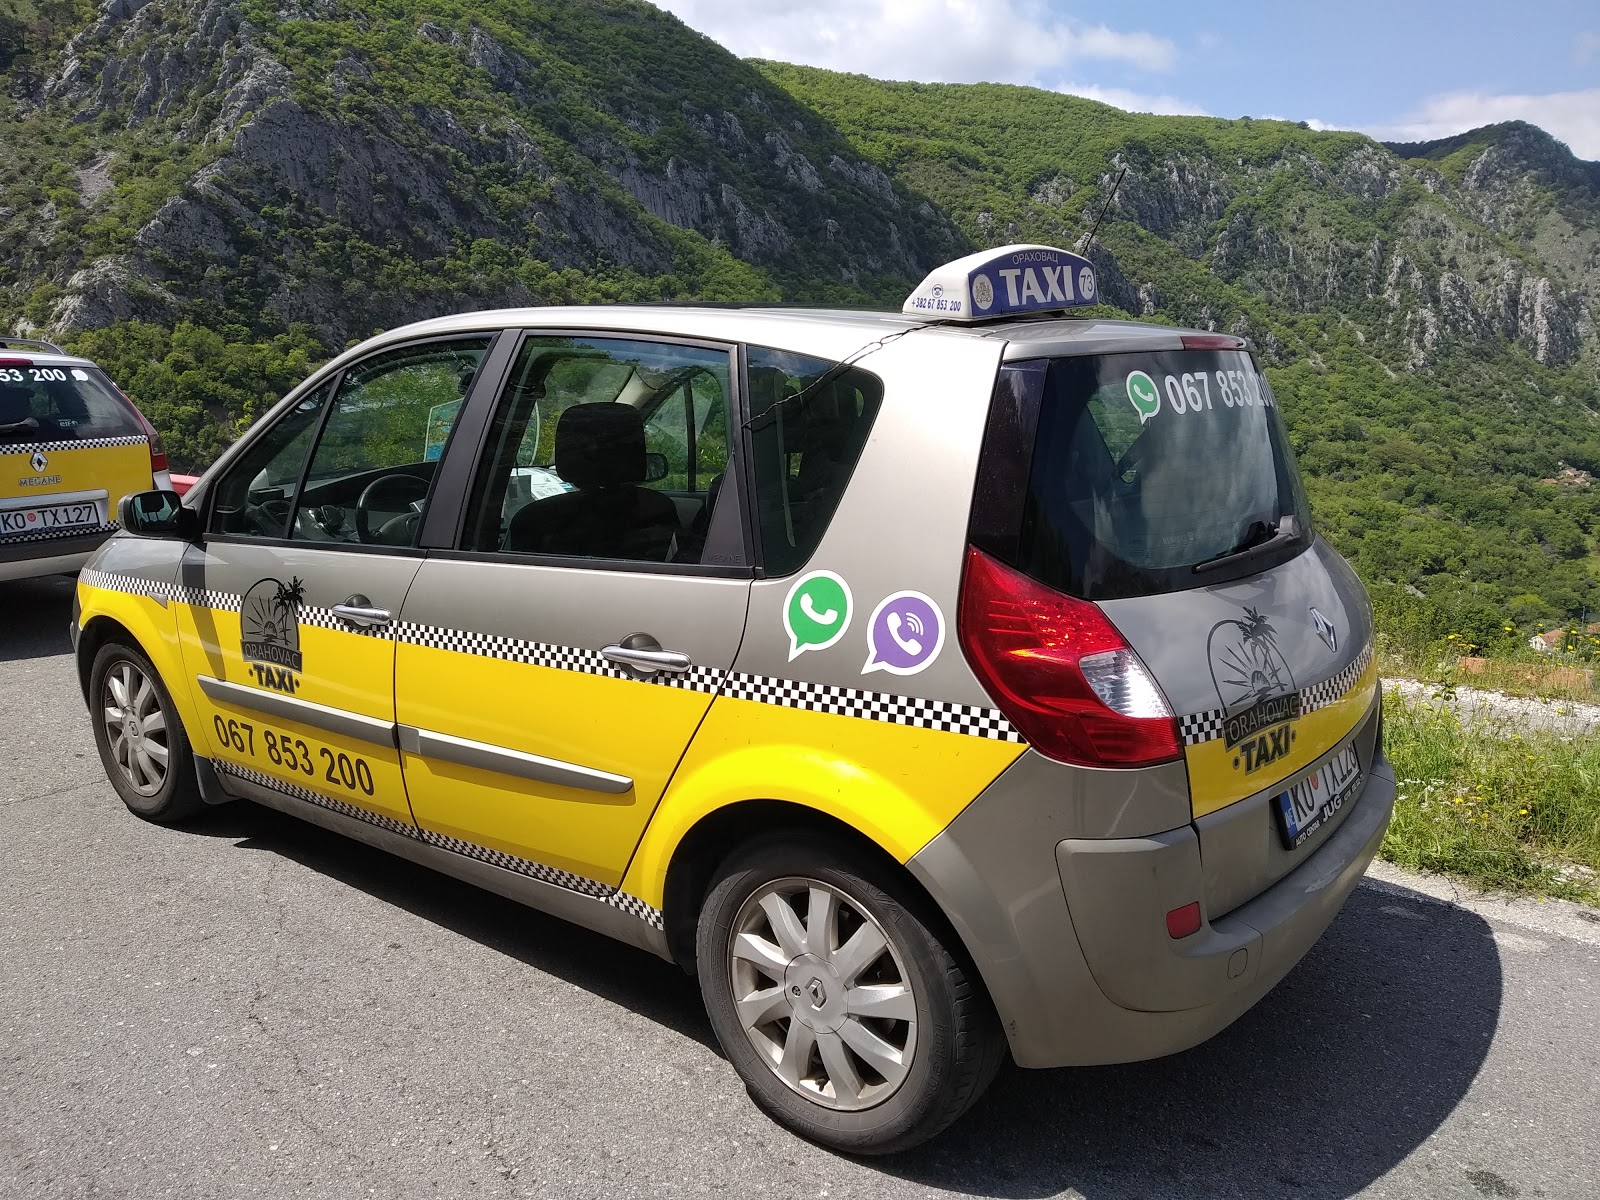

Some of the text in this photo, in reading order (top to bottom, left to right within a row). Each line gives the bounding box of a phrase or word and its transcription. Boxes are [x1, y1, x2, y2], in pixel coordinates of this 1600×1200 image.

[999, 265, 1075, 307] TAXI
[1081, 274, 1094, 293] 73
[911, 297, 962, 312] +382 67 853 200
[28, 369, 67, 382] 200
[1164, 371, 1213, 415] 067
[1215, 370, 1253, 408] 853
[19, 475, 62, 486] MEGANE
[1, 505, 93, 531] KO TX127
[245, 643, 299, 669] ORAHOVAC
[253, 663, 295, 694] TAXI
[1229, 694, 1298, 742] ORAHOVAC
[213, 714, 374, 796] 067 853 200
[1240, 723, 1291, 774] TAXI
[1322, 794, 1342, 822] JUG
